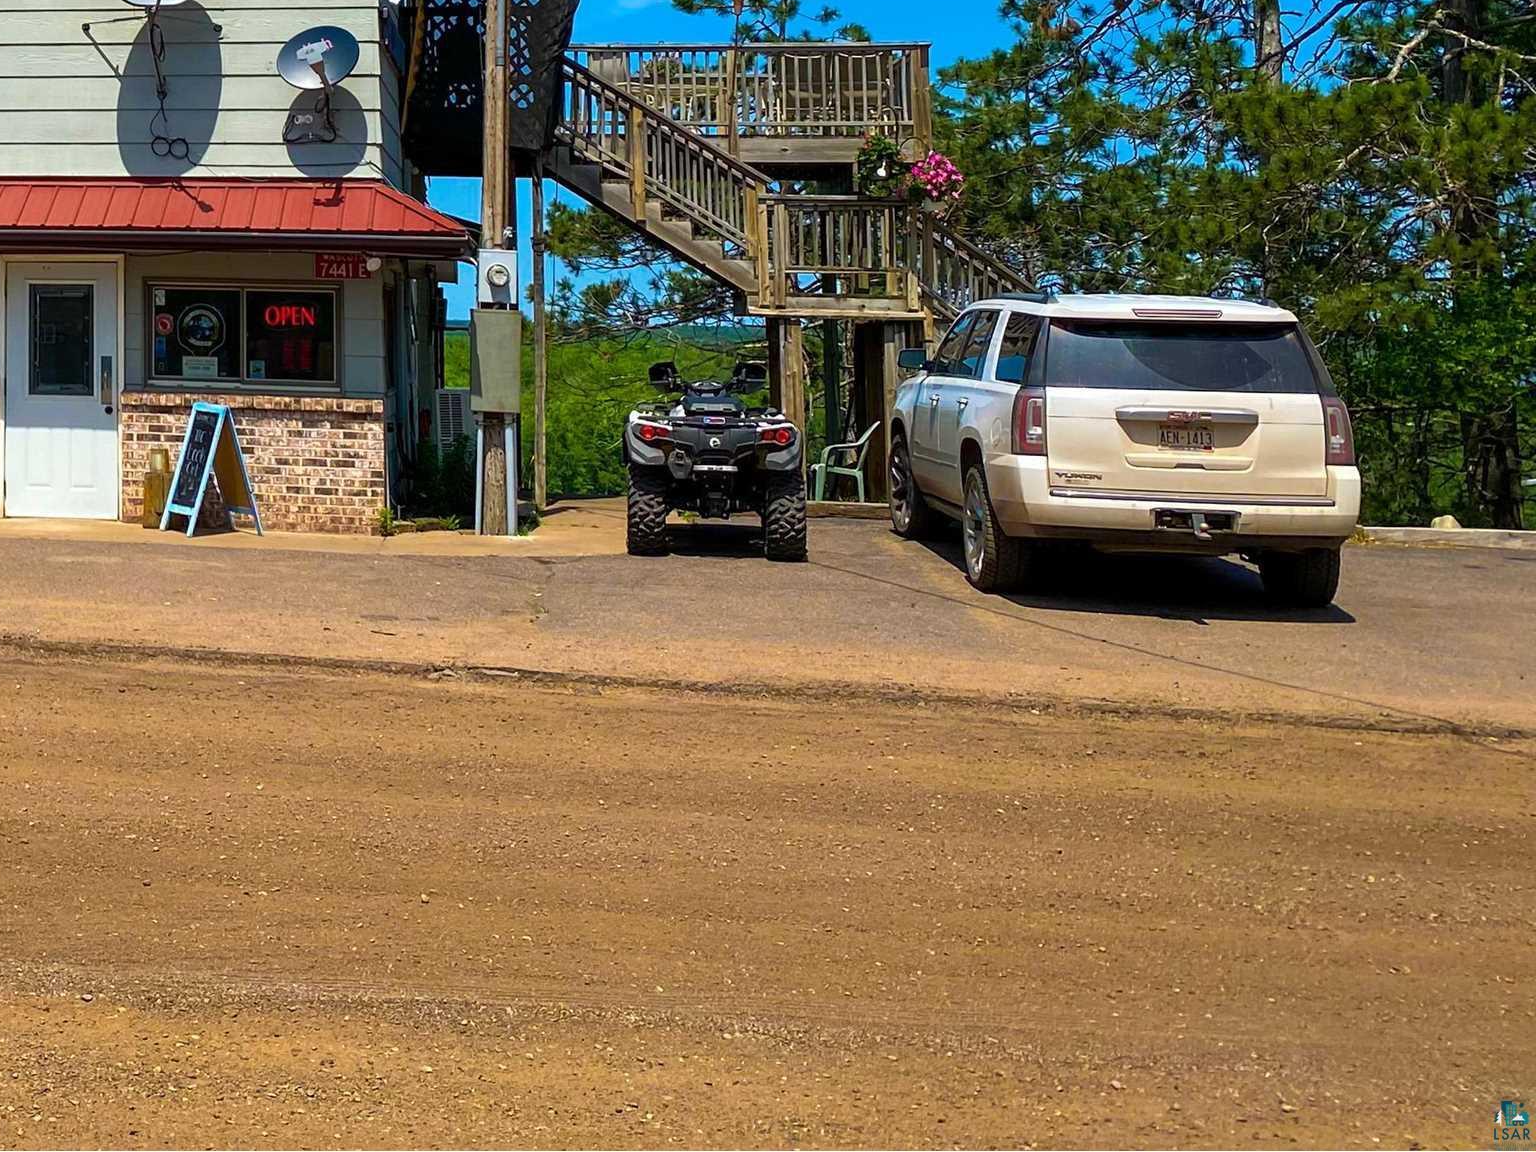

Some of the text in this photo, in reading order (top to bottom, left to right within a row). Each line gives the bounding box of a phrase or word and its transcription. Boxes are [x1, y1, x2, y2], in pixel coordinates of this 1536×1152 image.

[319, 263, 367, 278] 7441 E
[265, 305, 316, 326] OPEN
[1055, 471, 1102, 480] YUKON
